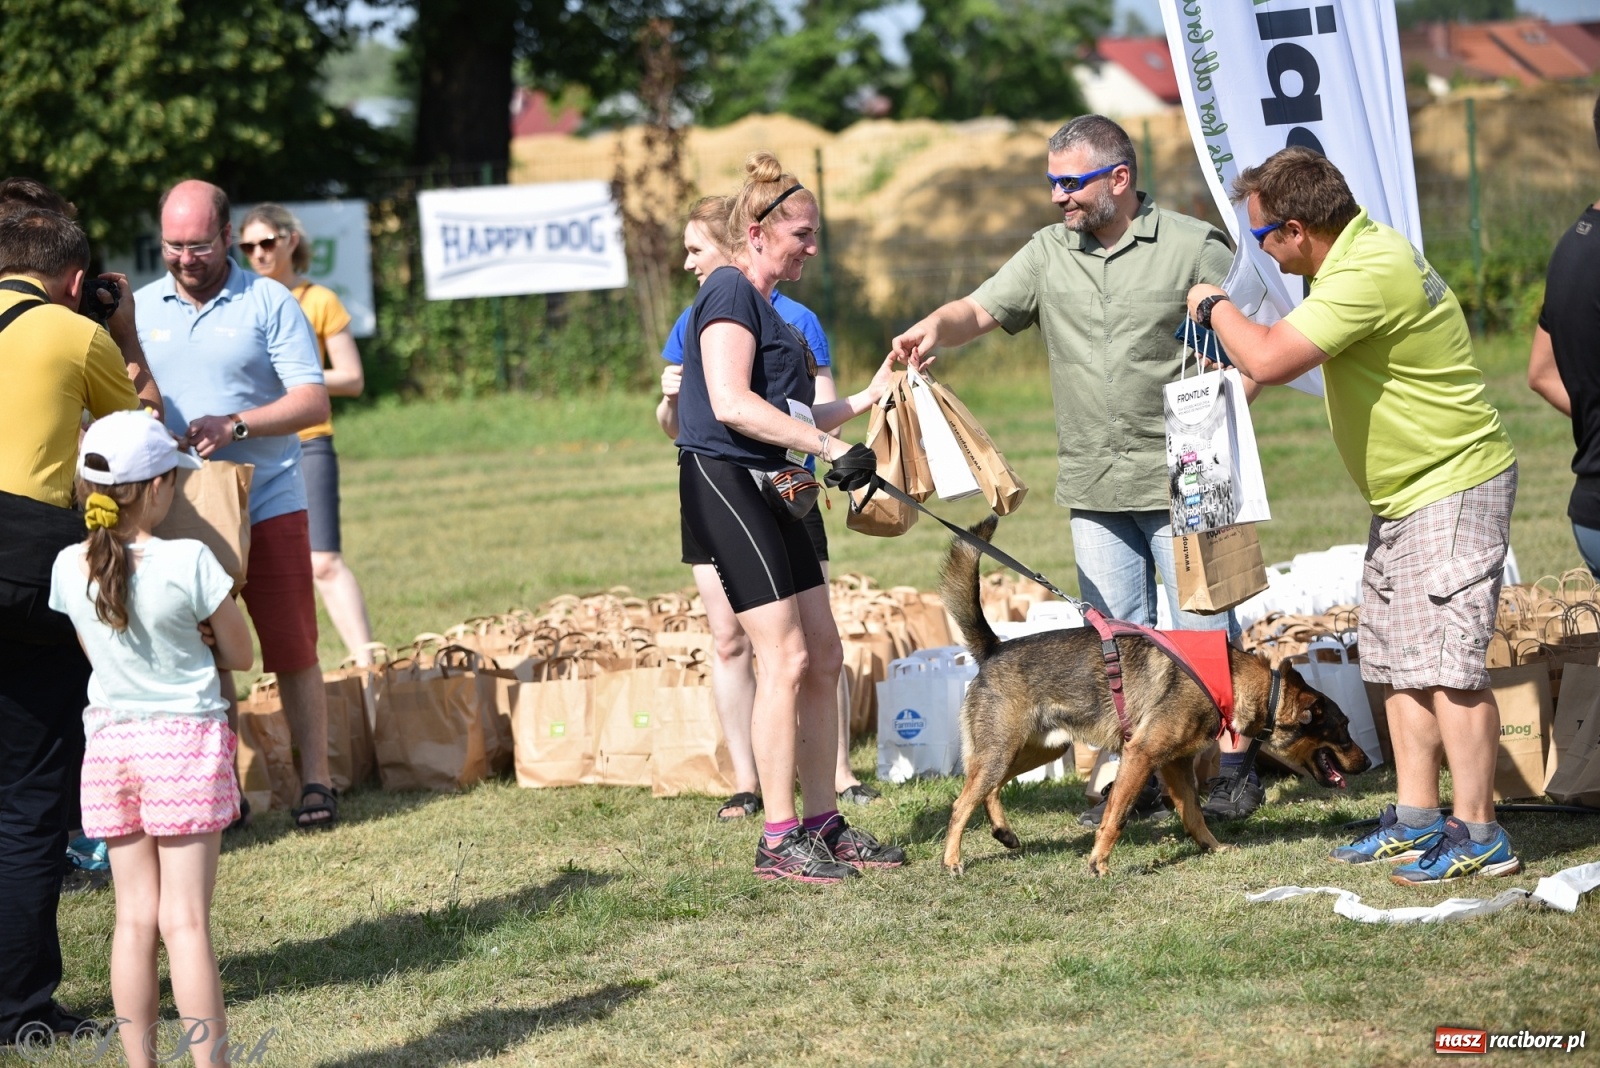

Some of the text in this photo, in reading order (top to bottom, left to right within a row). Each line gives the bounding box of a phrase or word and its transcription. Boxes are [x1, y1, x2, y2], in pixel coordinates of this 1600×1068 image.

[440, 214, 605, 265] HAPPY DOG
[1177, 386, 1210, 404] FRONTLINE
[894, 719, 924, 730] Farmina
[1500, 723, 1532, 737] iDog
